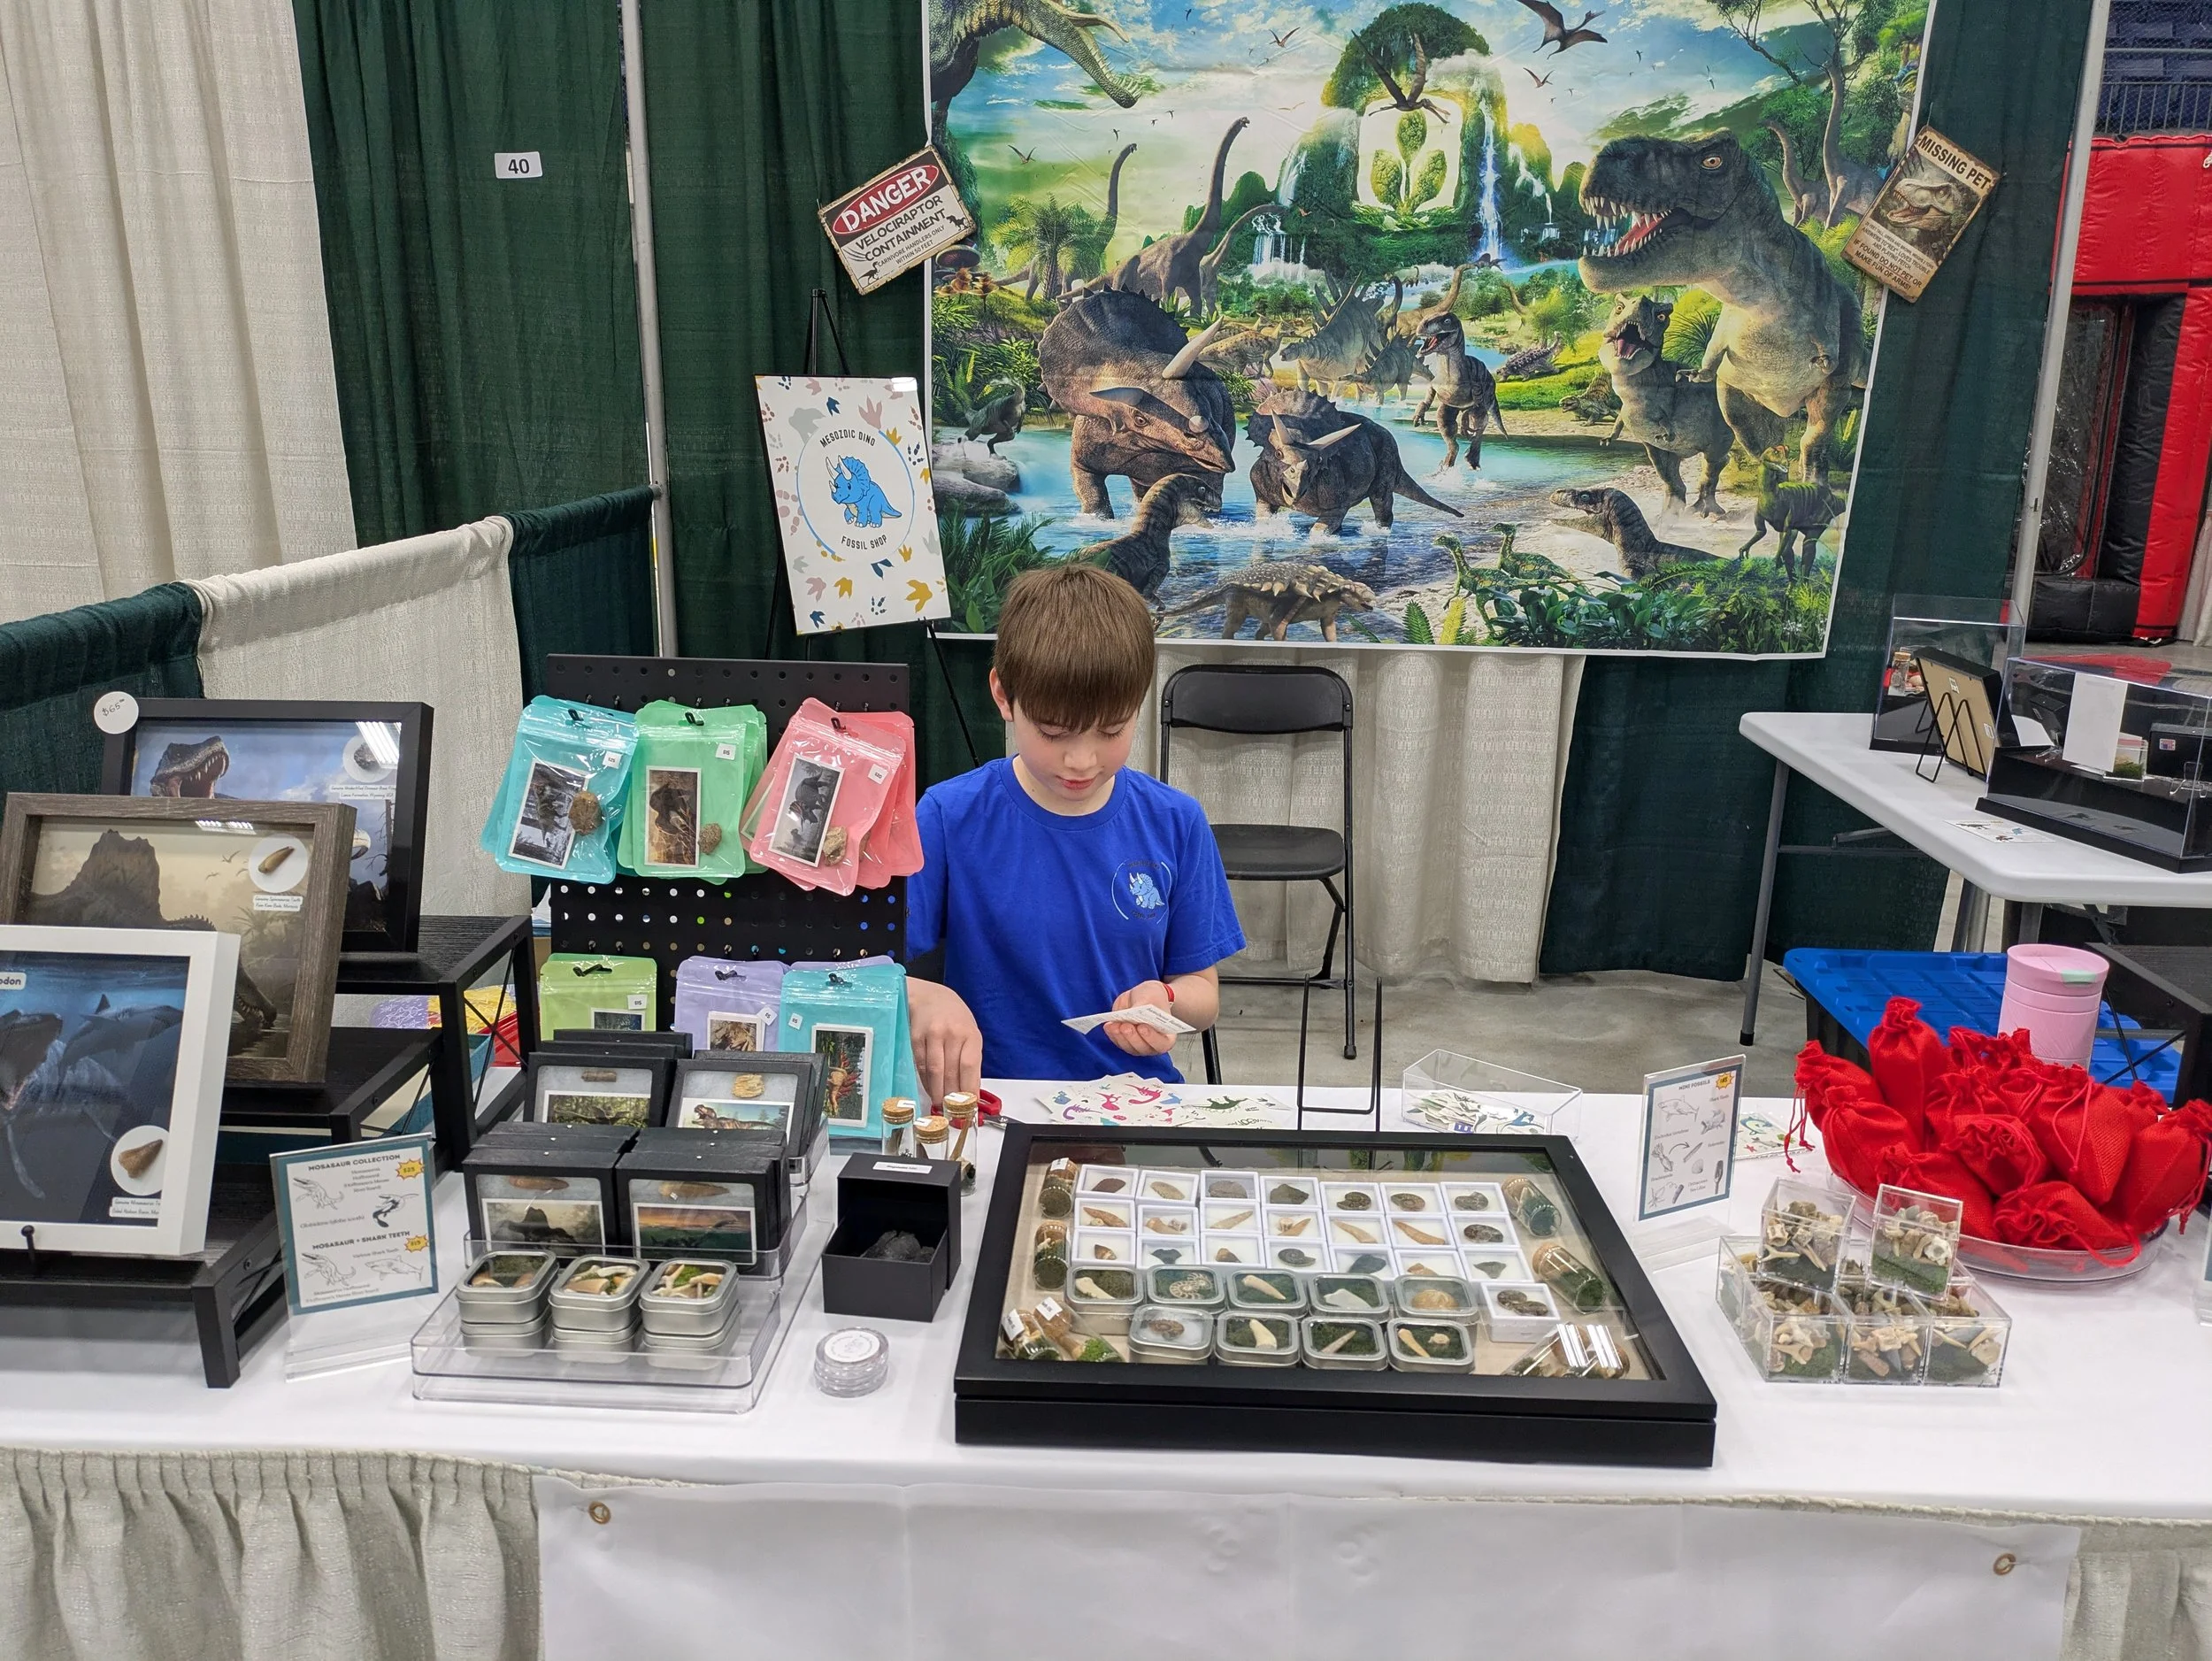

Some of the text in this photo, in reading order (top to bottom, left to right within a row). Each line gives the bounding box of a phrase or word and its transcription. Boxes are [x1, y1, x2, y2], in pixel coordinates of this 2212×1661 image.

[508, 158, 530, 174] 40
[1918, 135, 1991, 189] MISSING PET
[841, 166, 932, 232] DANGER
[856, 195, 943, 250] VELOCIRAPTOR
[865, 208, 946, 261] CONTAINMENT
[878, 225, 945, 266] CARNIVORE HANDLERS ONLY
[895, 251, 915, 264] WITHIN
[921, 240, 933, 250] FEET
[1859, 242, 1880, 259] FOUND
[1878, 256, 1890, 265] DO
[1888, 262, 1901, 273] NOT
[1901, 270, 1913, 281] PET
[1911, 278, 1923, 288] OR
[1862, 227, 1882, 242] ANSWERS
[1898, 251, 1912, 263] LOVES
[1911, 260, 1931, 274] TROUBLE
[1871, 242, 1882, 250] AND
[1880, 247, 1899, 261] PLAYING
[1855, 250, 1912, 290] MAKE FUN OF ARMS!
[819, 429, 876, 448] MESOZOIC DINO
[841, 534, 887, 550] FOSSIL SHOP
[308, 1160, 351, 1172] MOSASAUR
[352, 1154, 401, 1165] COLLECTION
[312, 1238, 354, 1250] MOSASAUR
[361, 1234, 387, 1243] SHARK
